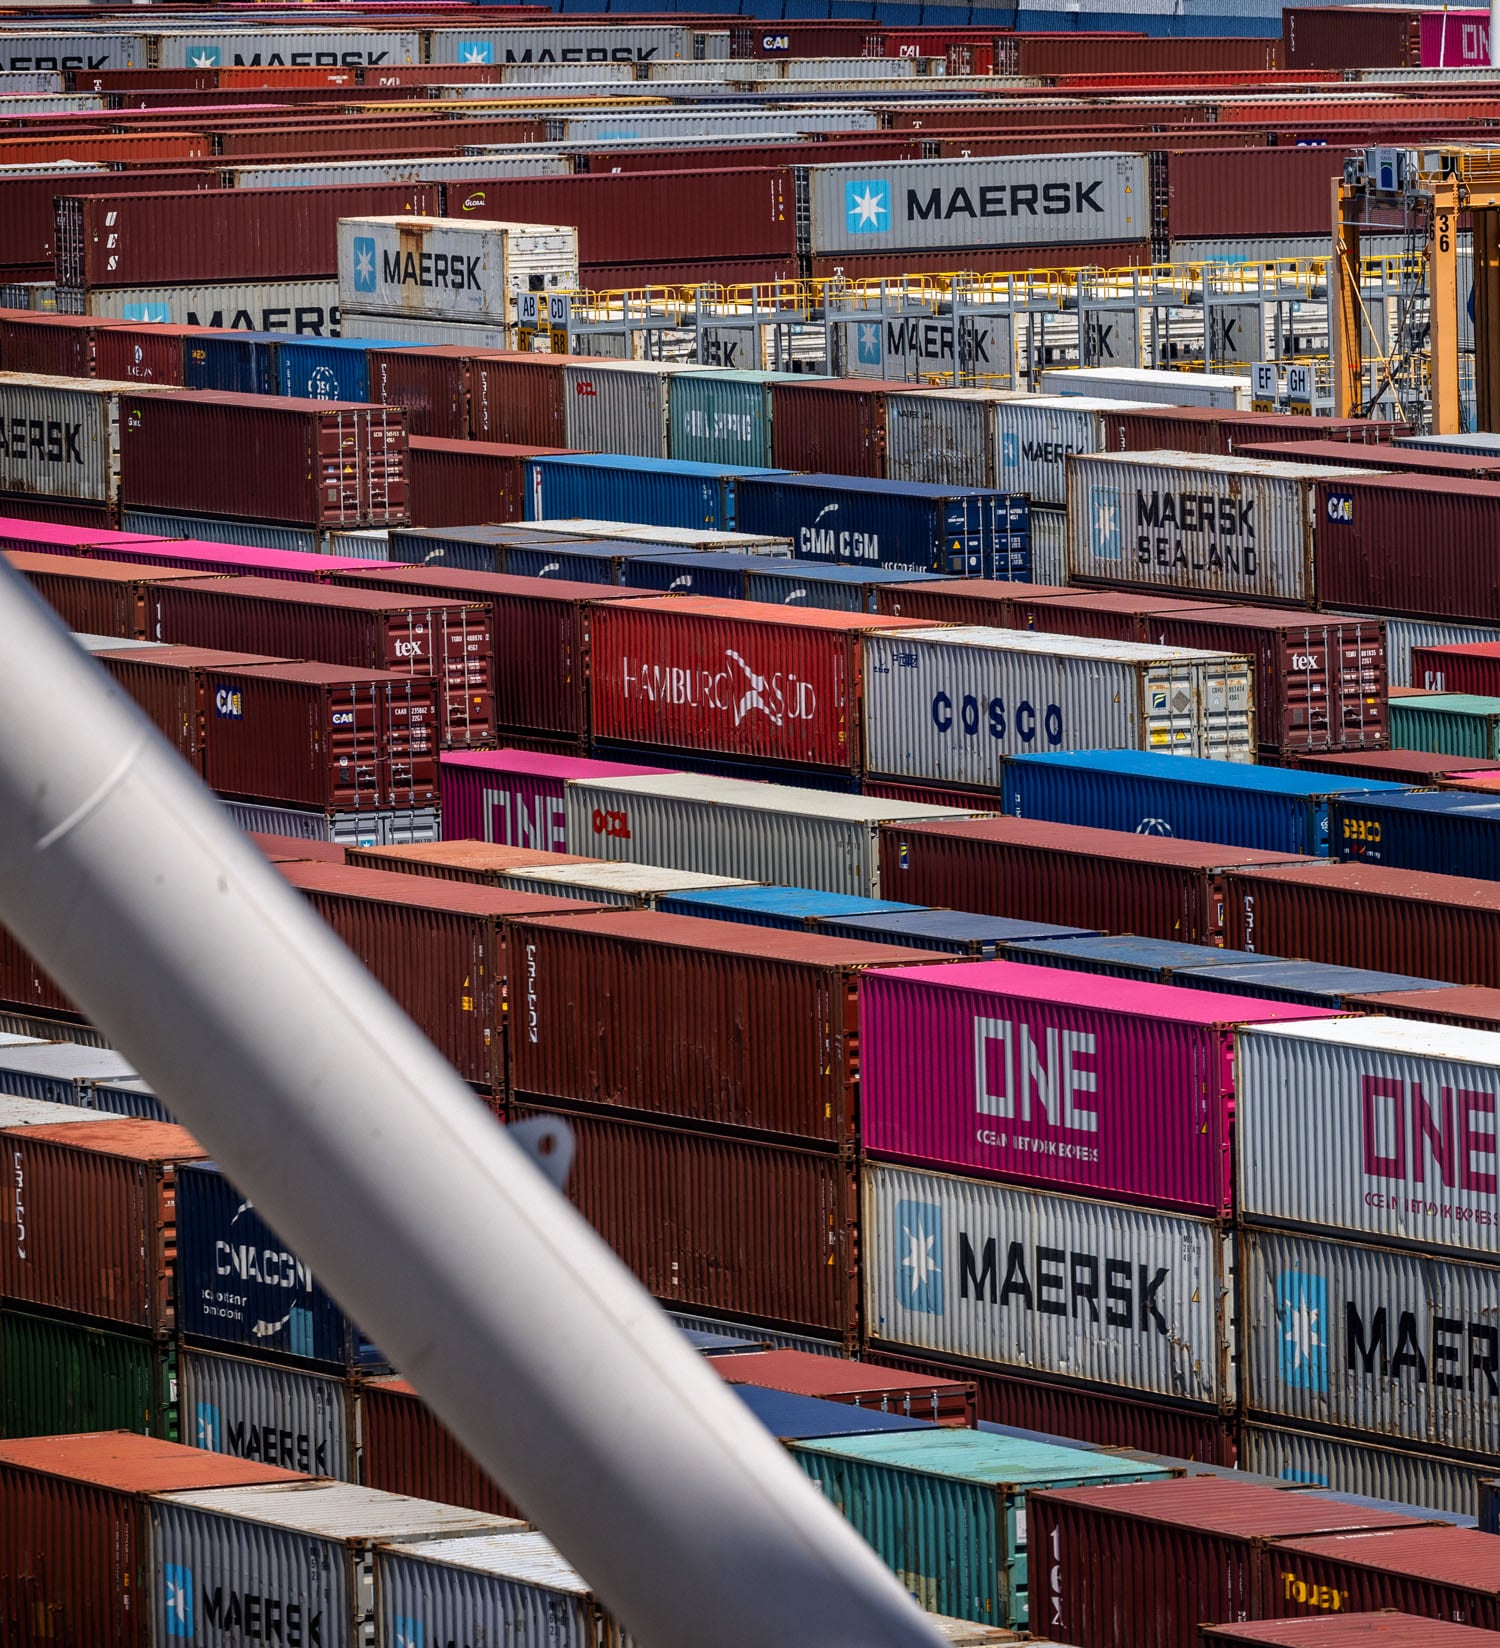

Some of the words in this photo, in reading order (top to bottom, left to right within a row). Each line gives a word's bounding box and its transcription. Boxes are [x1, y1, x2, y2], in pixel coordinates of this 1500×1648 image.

[908, 181, 1104, 221] MAERSK
[383, 248, 481, 293] MAERSK
[522, 296, 536, 318] AB
[551, 299, 564, 319] CD
[1258, 368, 1271, 392] EF
[1290, 369, 1306, 393] GH
[1137, 489, 1256, 539] MAERSK
[801, 526, 836, 558] CMA
[839, 530, 879, 560] CGM
[1137, 535, 1257, 577] SEALAND
[1292, 652, 1319, 670] tex
[932, 690, 1063, 745] COSCO
[593, 808, 631, 839] OOCL
[974, 1016, 1097, 1132] ONE
[1362, 1074, 1497, 1194] ONE
[959, 1232, 1170, 1336] MAERSK
[227, 1418, 327, 1476] MAERSK
[202, 1587, 323, 1644] MAERSK
